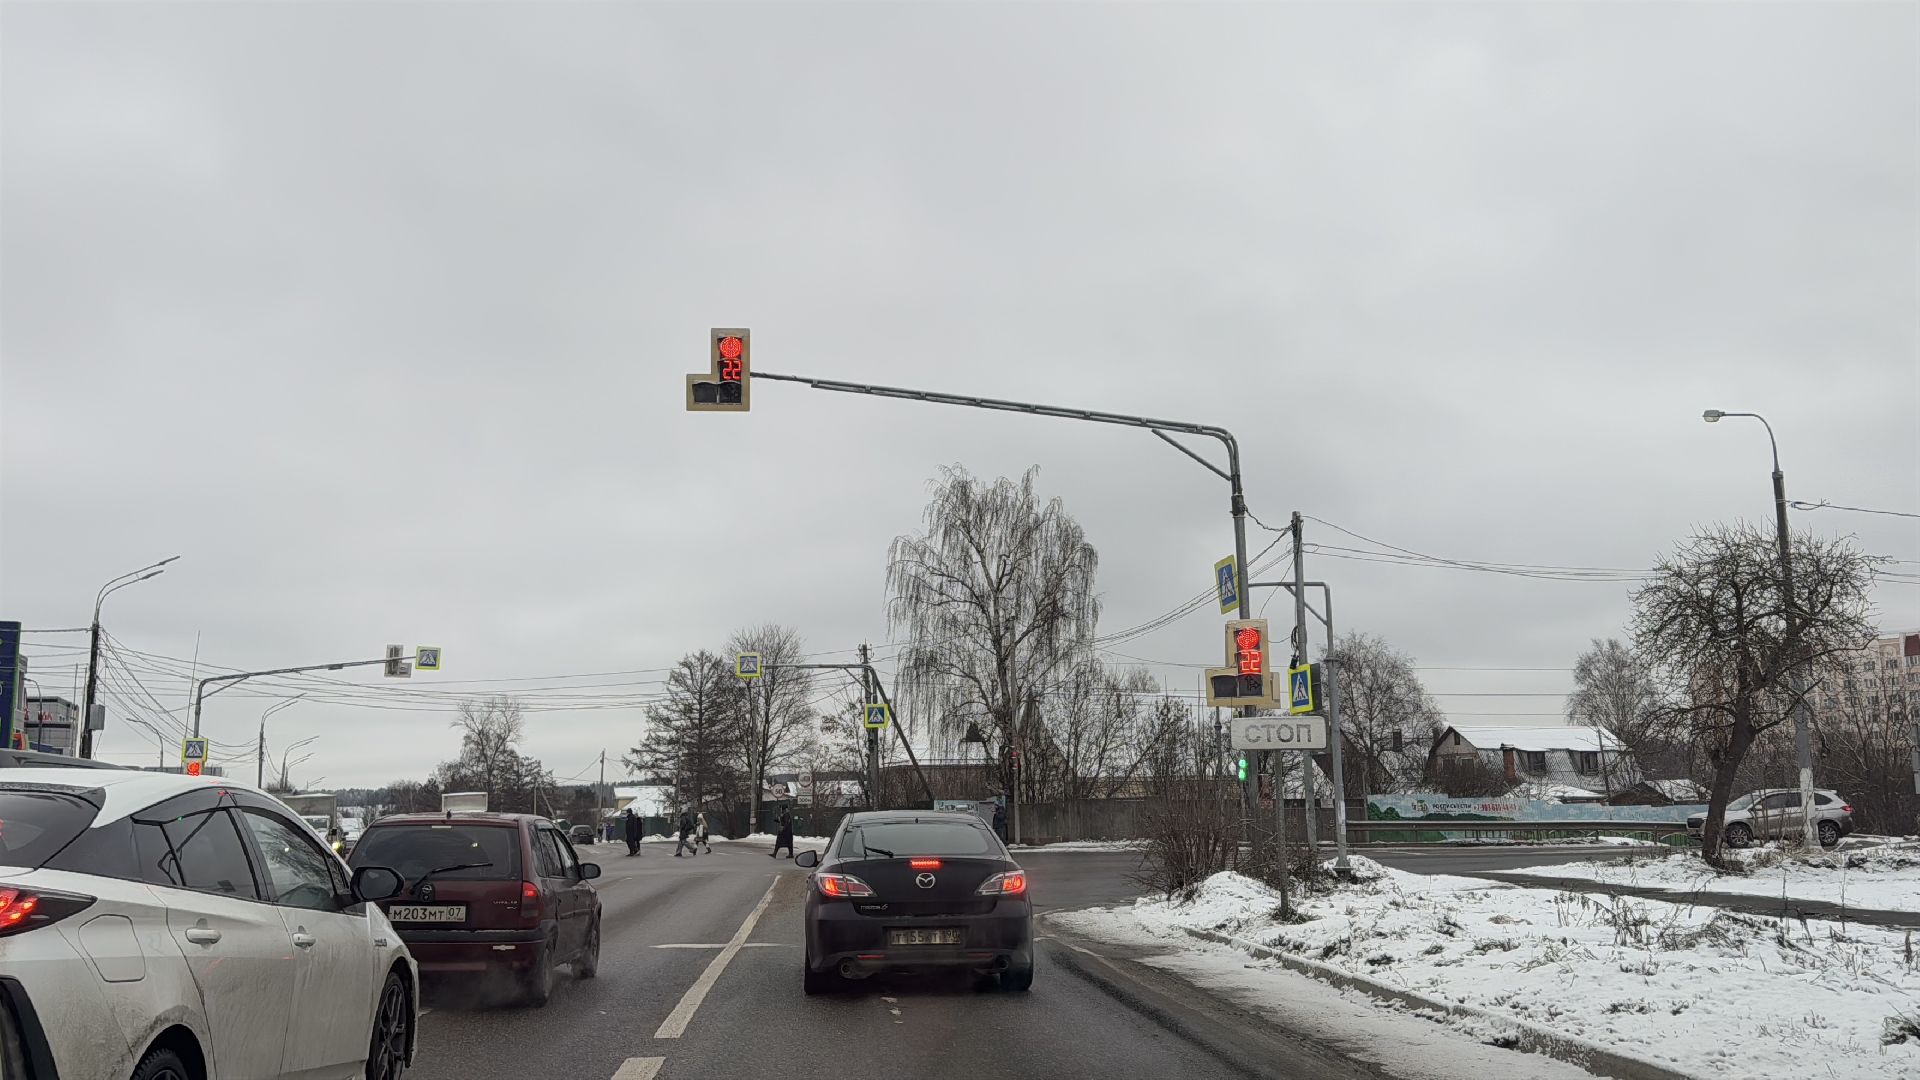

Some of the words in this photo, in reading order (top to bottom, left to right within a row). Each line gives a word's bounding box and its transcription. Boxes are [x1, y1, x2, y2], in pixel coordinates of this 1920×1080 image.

[722, 360, 742, 380] 22
[1240, 651, 1260, 671] 22
[1244, 723, 1312, 743] СТОП
[393, 907, 445, 921] М203МТ
